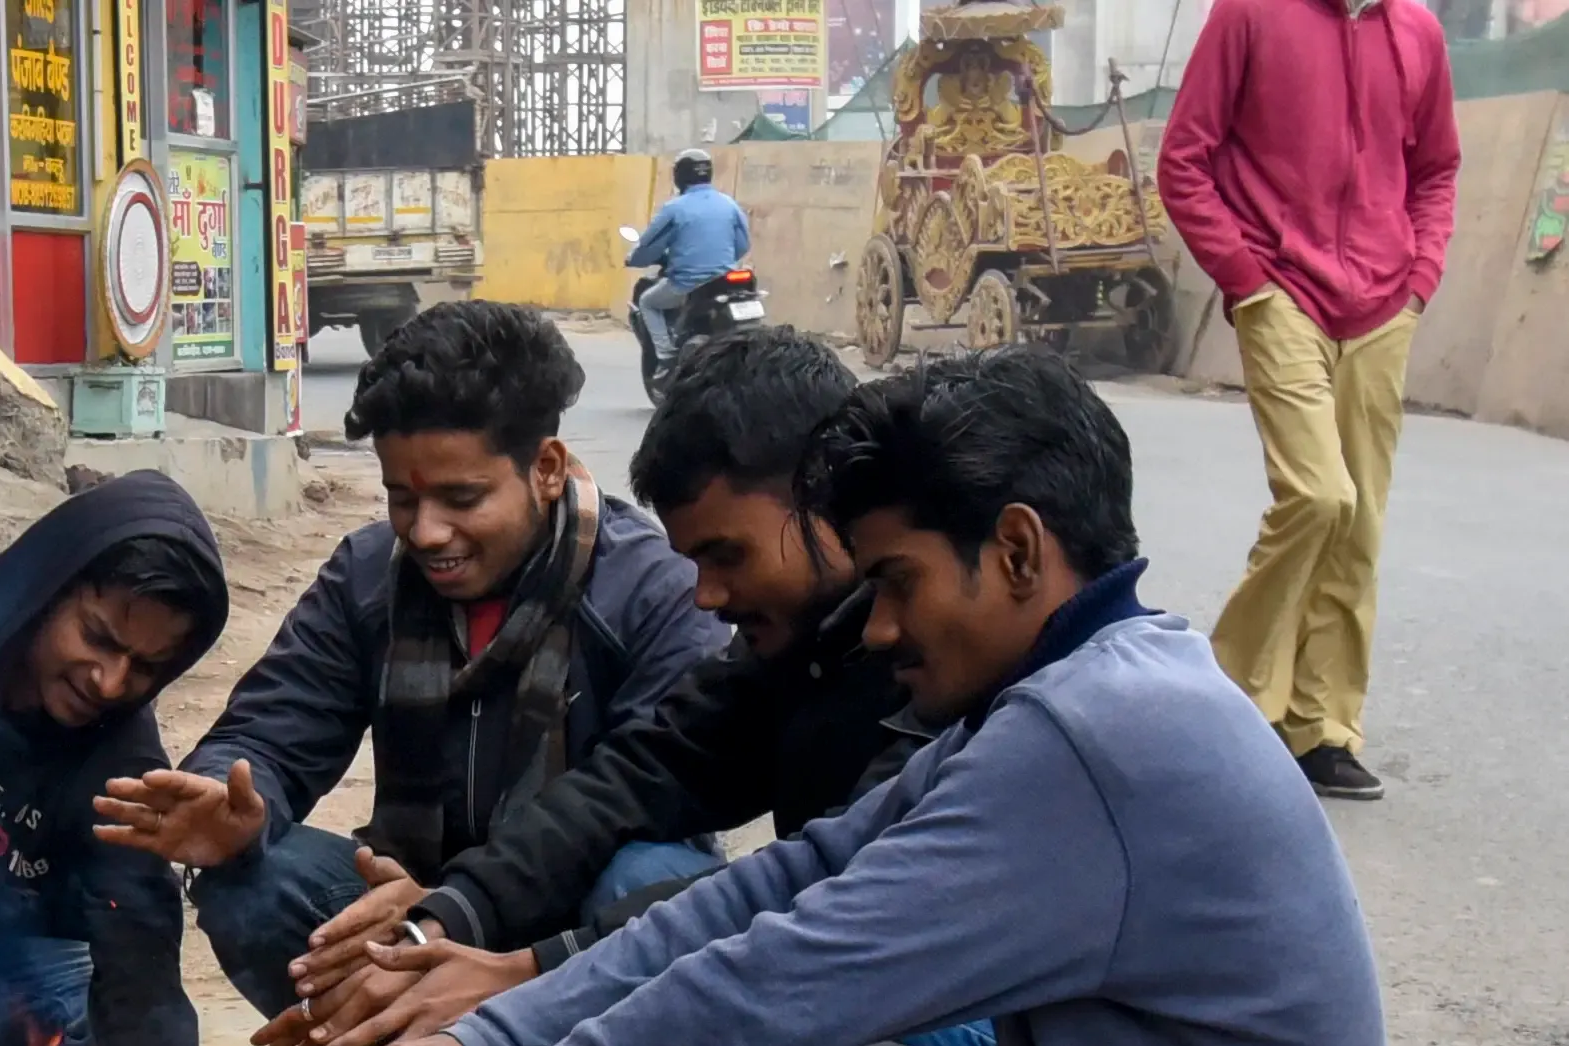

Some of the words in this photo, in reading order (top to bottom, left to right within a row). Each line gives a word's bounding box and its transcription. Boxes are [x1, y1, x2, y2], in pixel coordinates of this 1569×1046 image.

[10, 35, 45, 93] पंजाब
[272, 12, 292, 334] DURGA
[172, 189, 191, 237] माँ
[196, 190, 227, 250] दुर्गा
